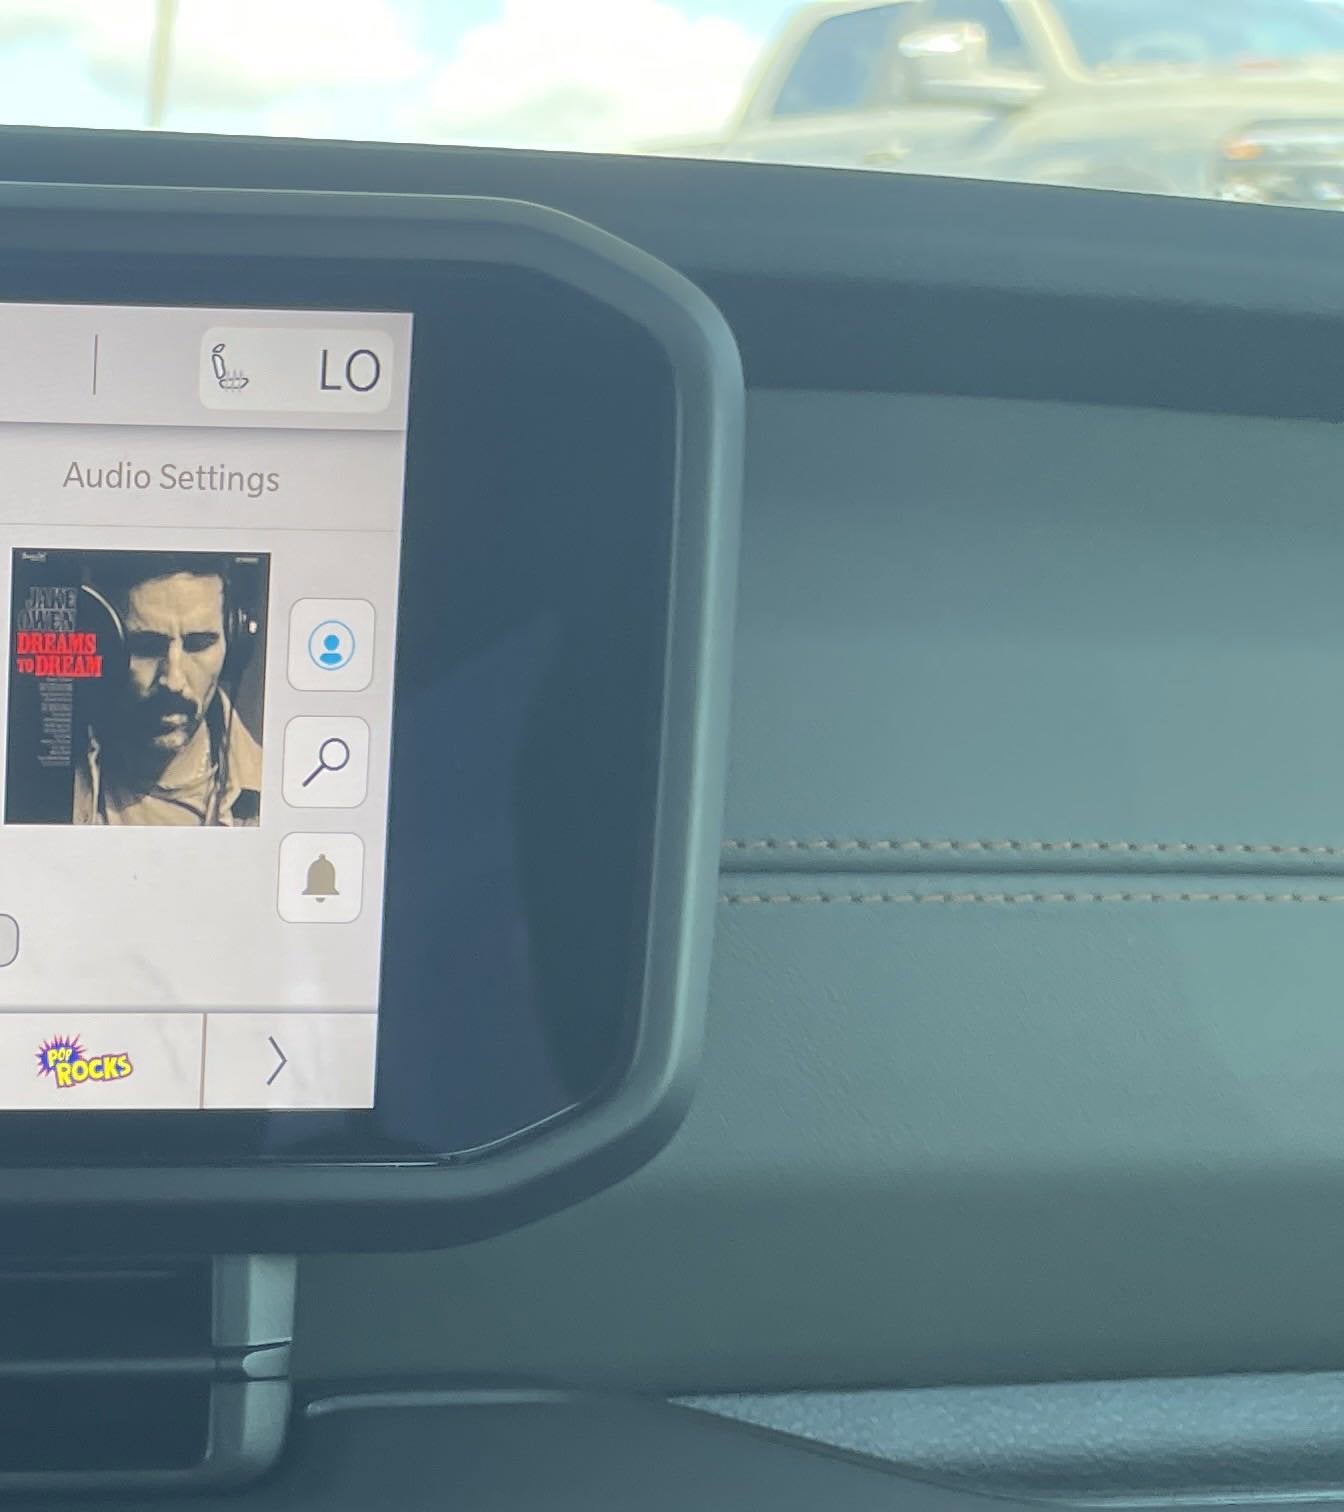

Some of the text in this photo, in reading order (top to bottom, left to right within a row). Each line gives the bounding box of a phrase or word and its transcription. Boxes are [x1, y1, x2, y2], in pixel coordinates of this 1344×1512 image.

[319, 347, 381, 395] LO
[63, 460, 280, 494] Audio Settings
[17, 632, 96, 655] DREAMS
[35, 656, 102, 677] DREAM
[47, 1047, 72, 1067] POP
[56, 1054, 132, 1087] ROCKS
